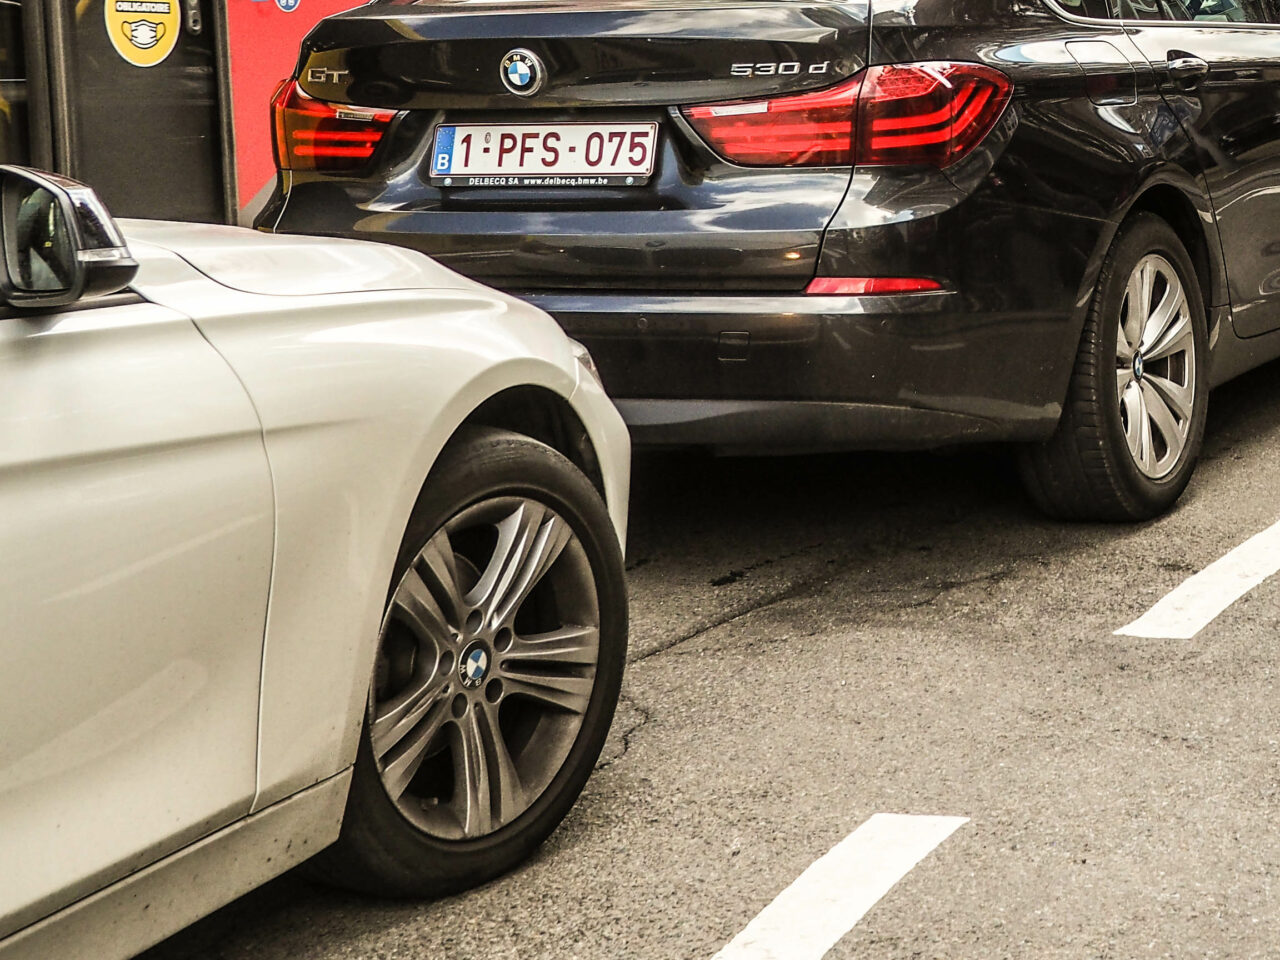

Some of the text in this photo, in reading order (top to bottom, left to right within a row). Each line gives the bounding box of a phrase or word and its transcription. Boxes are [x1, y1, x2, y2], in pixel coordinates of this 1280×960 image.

[116, 1, 170, 13] OBLIGATOIRE
[504, 54, 533, 68] BMW
[308, 67, 349, 83] GT
[730, 62, 801, 76] 530
[437, 131, 650, 170] B 1-PFS-075
[469, 177, 609, 186] DELBECQ SA www.delbecq.bmw.be
[459, 664, 482, 688] BMW
